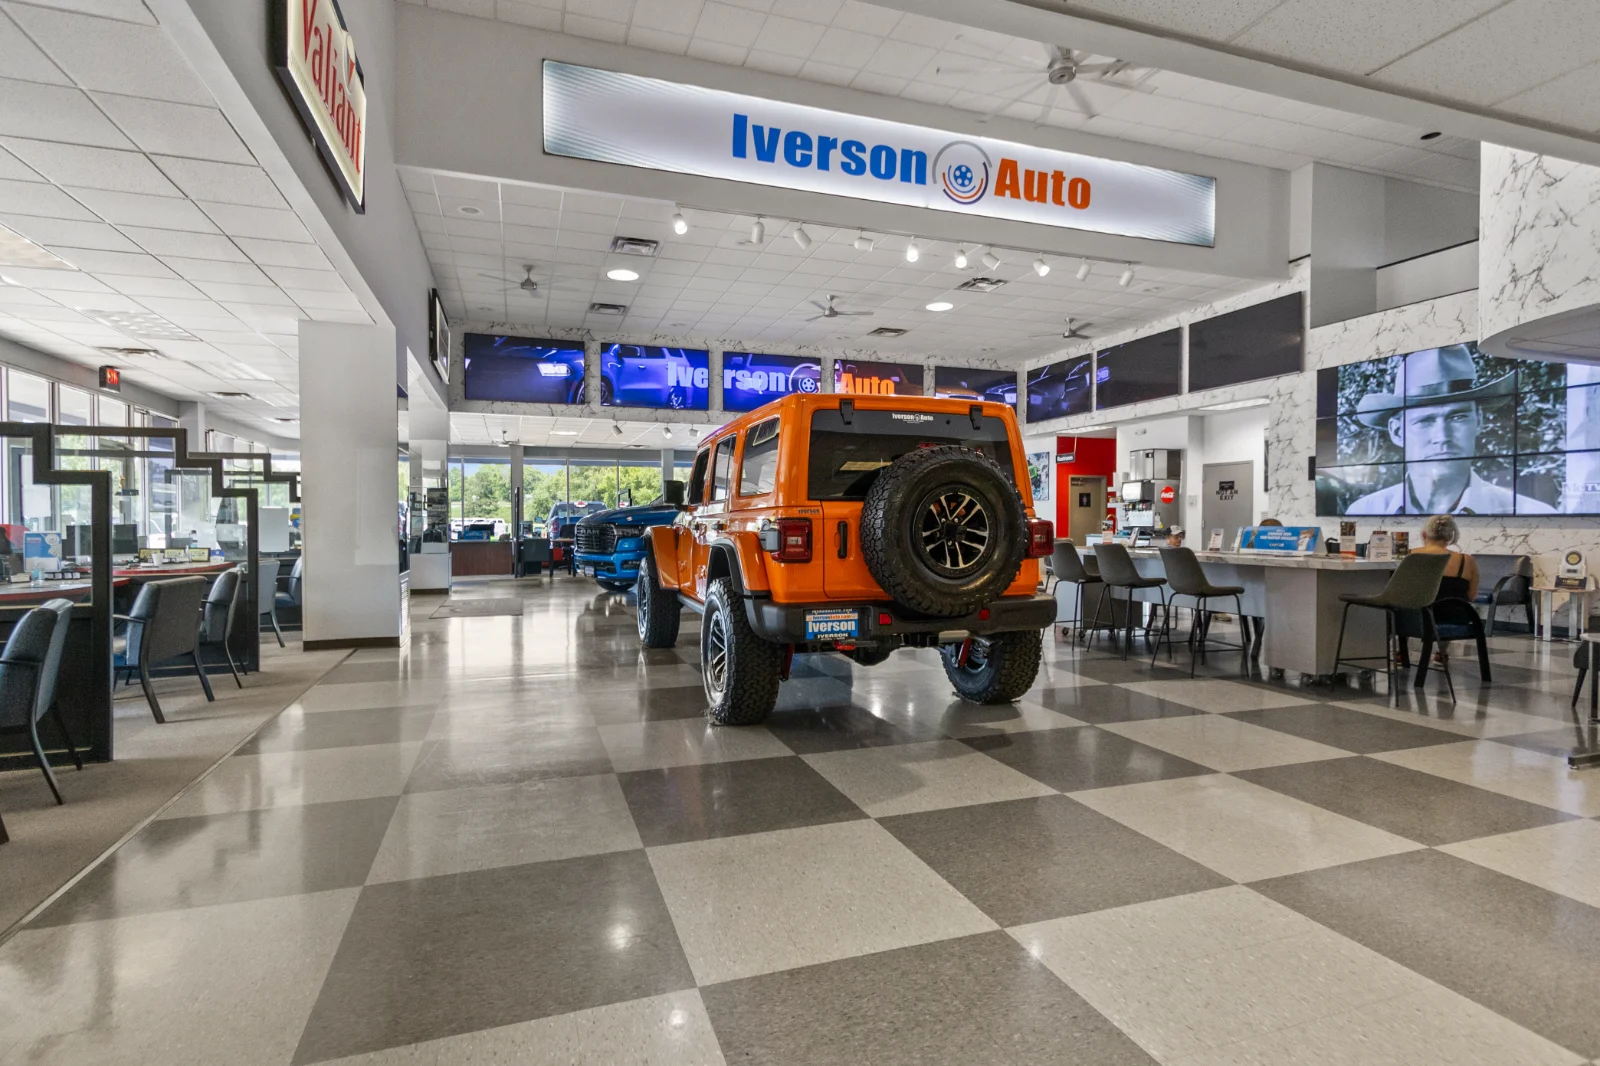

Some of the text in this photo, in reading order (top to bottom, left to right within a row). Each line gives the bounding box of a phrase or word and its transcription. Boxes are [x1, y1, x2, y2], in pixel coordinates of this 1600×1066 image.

[302, 0, 362, 175] Valiant
[732, 113, 1092, 211] Iverson Auto
[841, 372, 896, 394] Auto
[808, 620, 856, 633] Iverson
